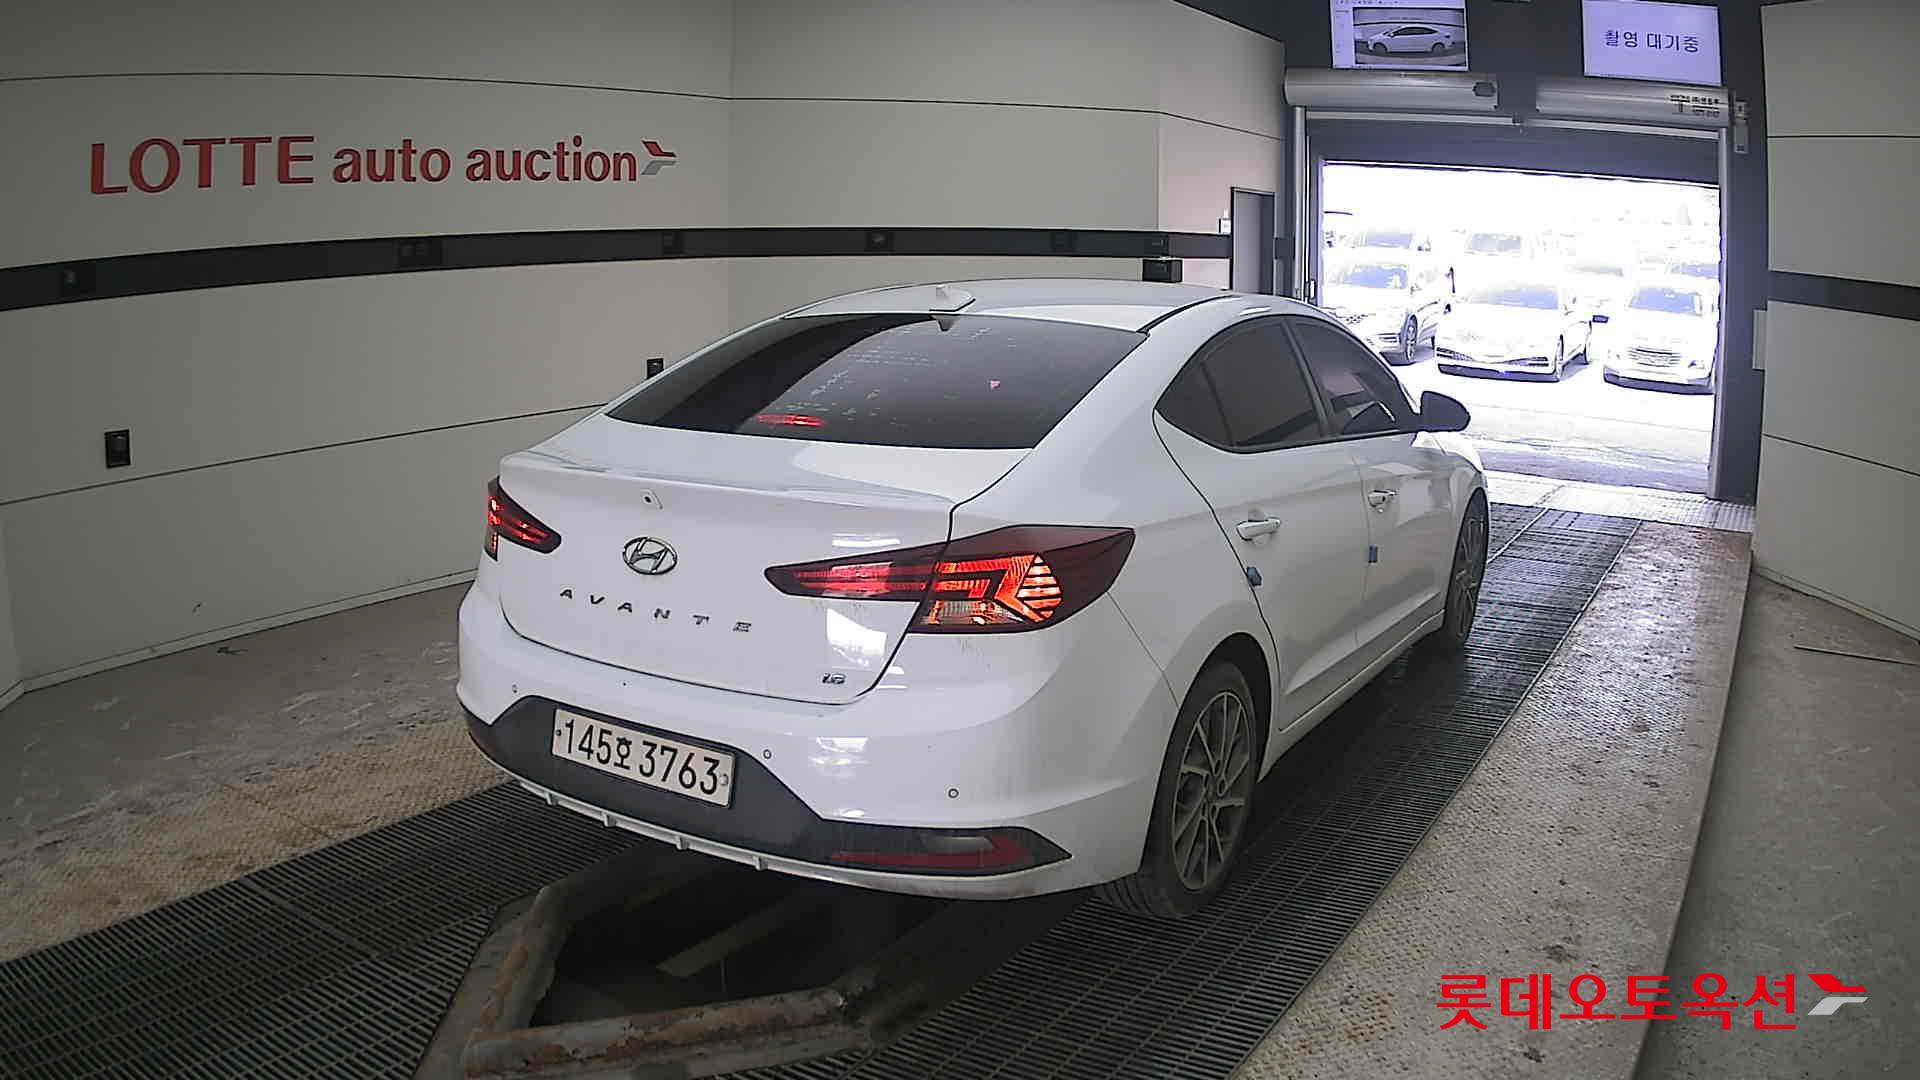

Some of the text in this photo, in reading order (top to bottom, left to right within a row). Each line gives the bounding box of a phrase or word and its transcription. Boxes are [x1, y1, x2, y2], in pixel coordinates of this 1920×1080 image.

[1647, 32, 1700, 54] 대기중
[91, 135, 638, 195] LOTTE auto auction
[560, 588, 752, 634] AVANTE
[564, 718, 721, 795] 145호 3763
